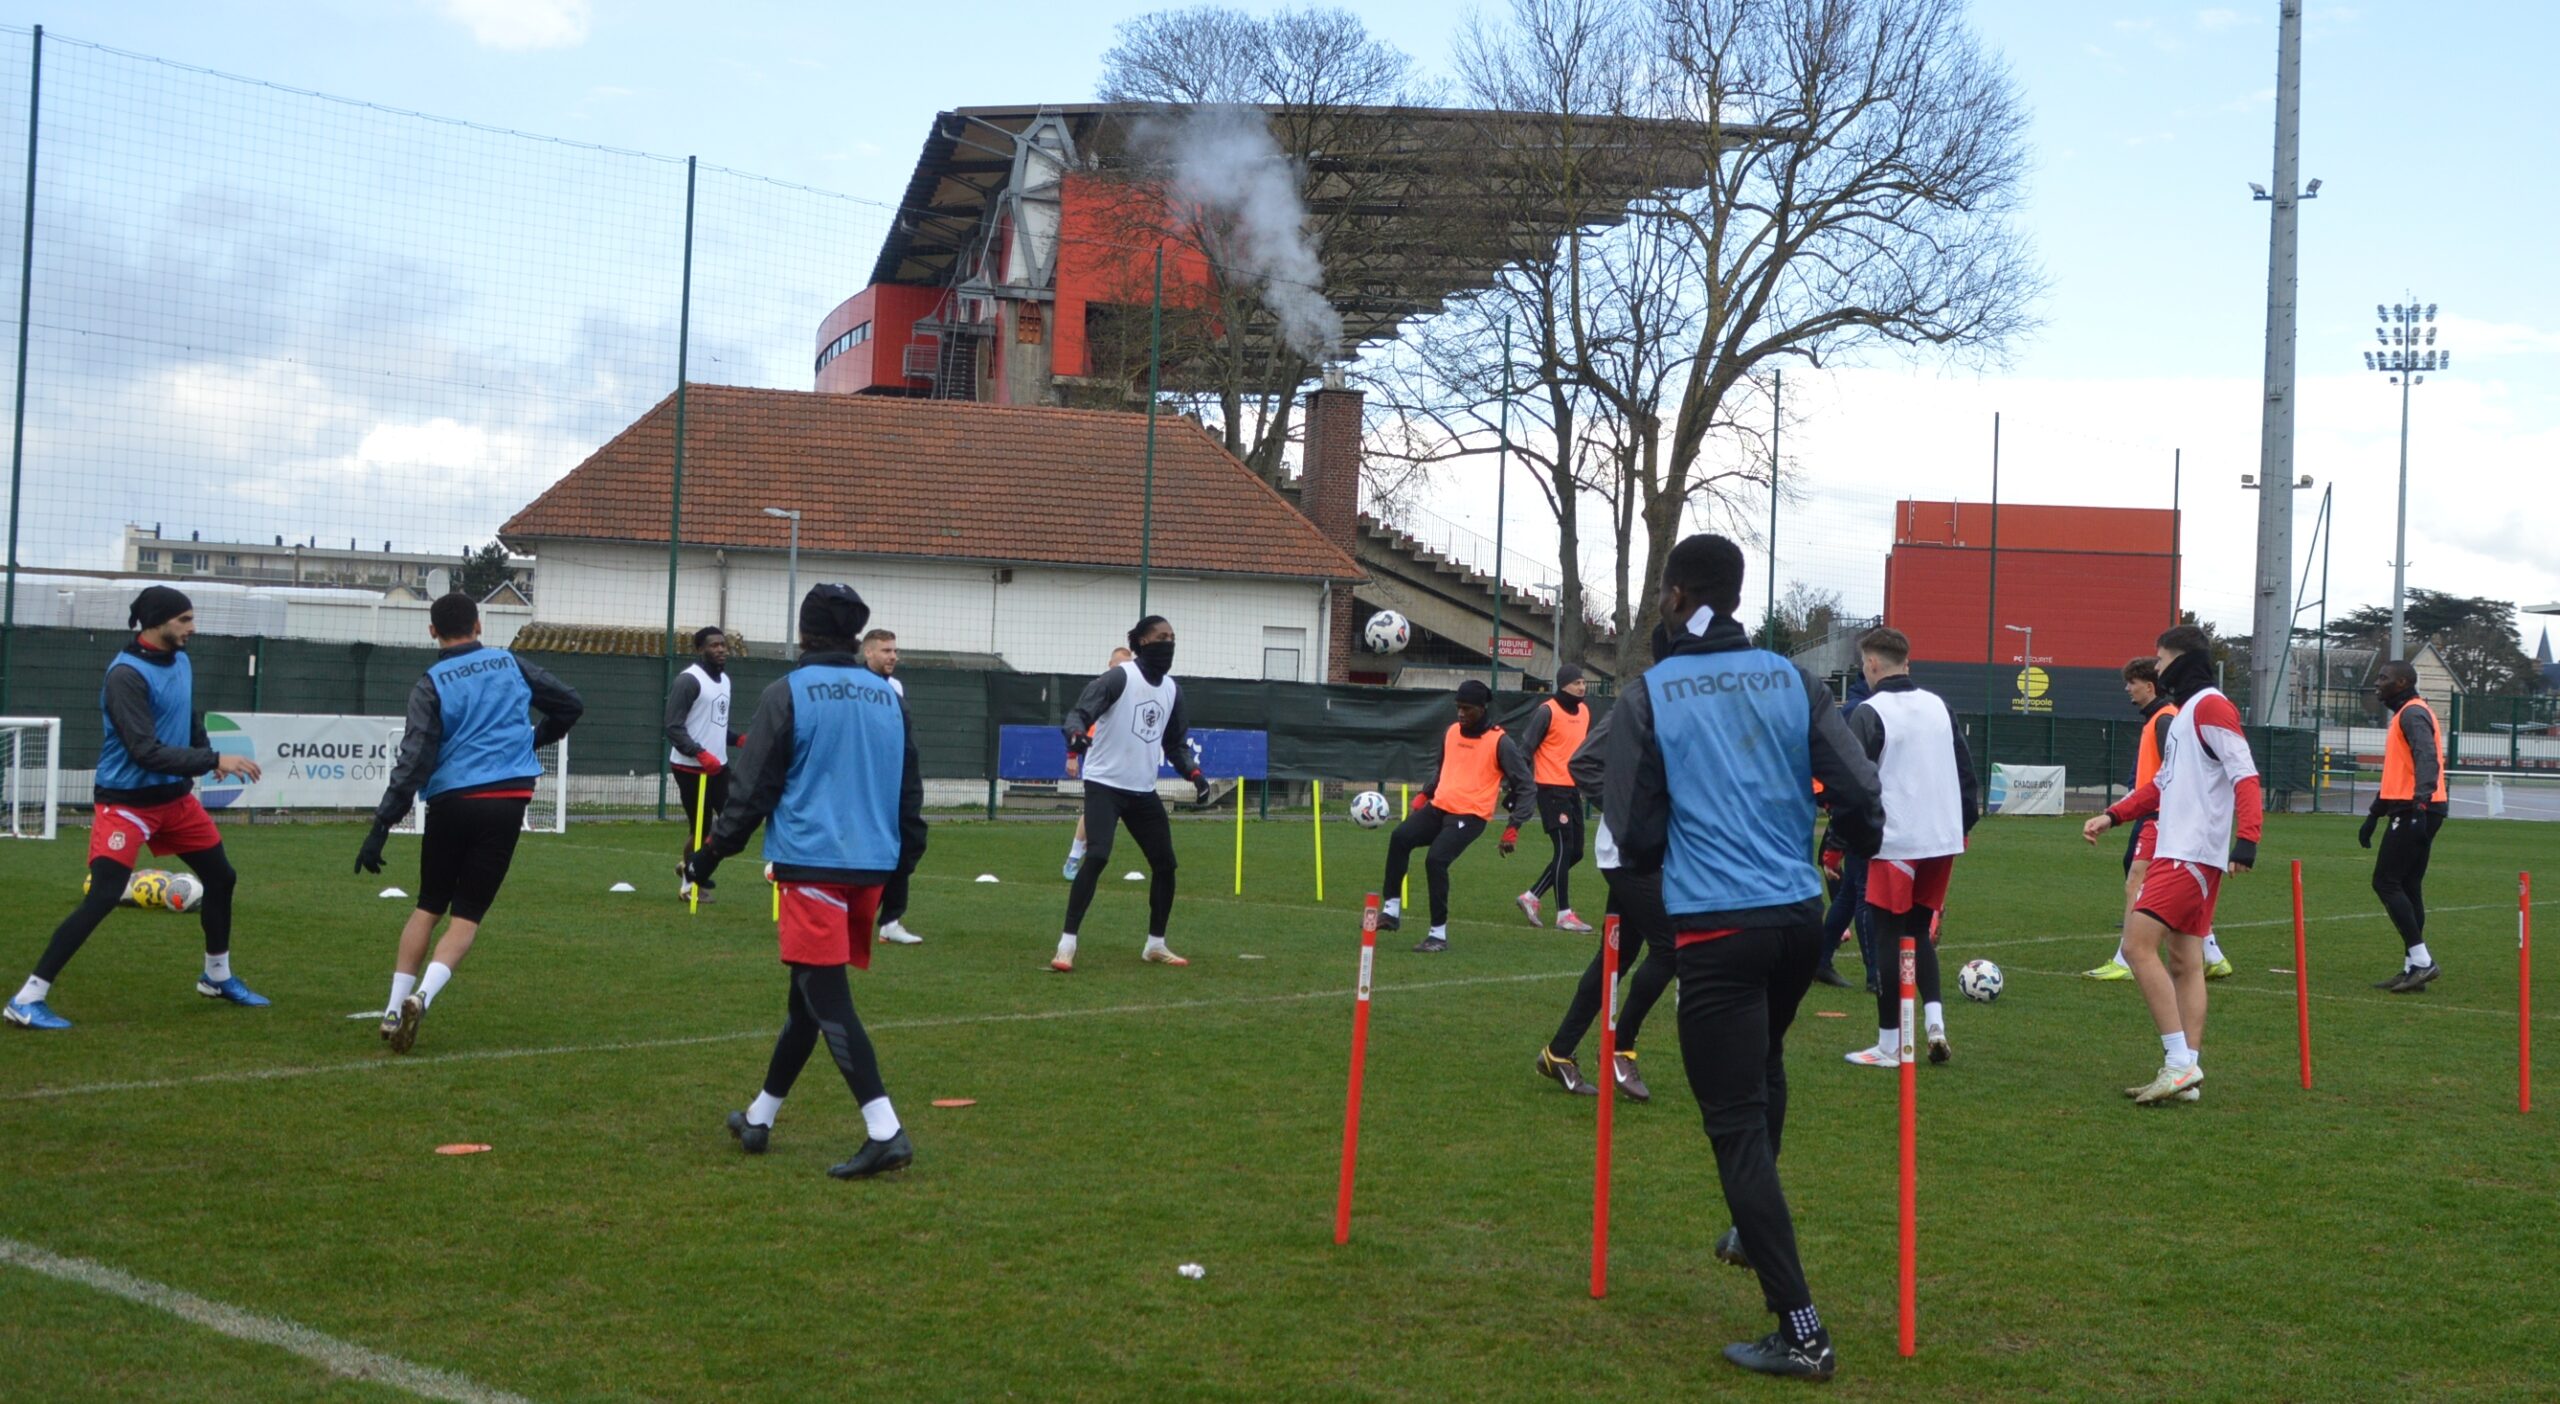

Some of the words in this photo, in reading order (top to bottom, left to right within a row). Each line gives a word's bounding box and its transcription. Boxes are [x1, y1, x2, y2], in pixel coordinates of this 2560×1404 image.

[1498, 640, 1529, 648] RIBUNE
[438, 656, 516, 686] macron
[807, 682, 892, 706] macron
[1661, 670, 1791, 703] macron
[2012, 697, 2052, 706] méropole
[277, 742, 363, 759] CHAQUE
[287, 761, 300, 779] À
[305, 764, 345, 779] VOS
